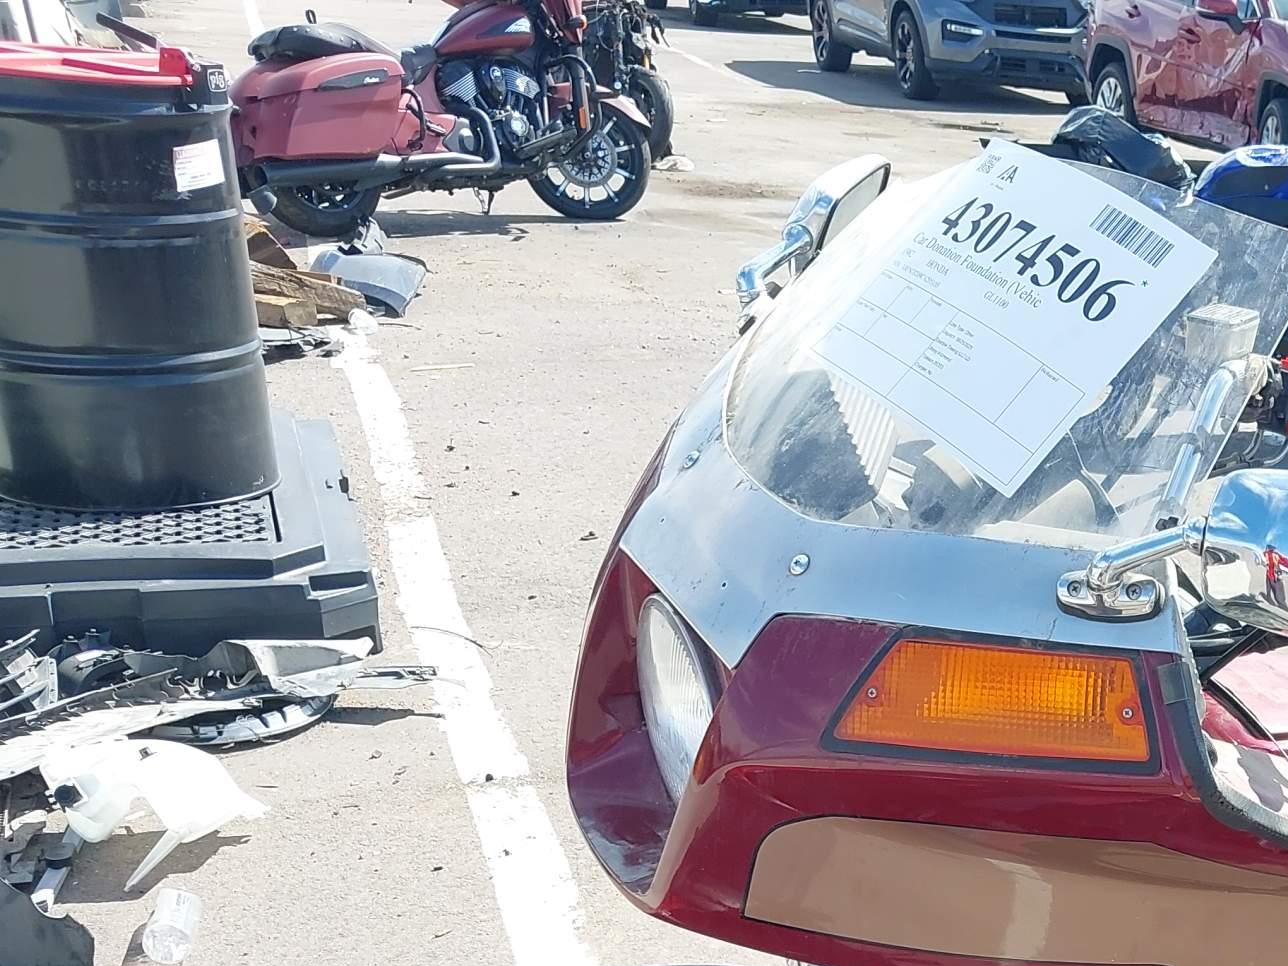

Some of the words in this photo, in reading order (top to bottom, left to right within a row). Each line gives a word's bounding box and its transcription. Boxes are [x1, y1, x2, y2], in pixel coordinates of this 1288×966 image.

[912, 231, 927, 246] Car
[926, 237, 962, 264] Donation
[960, 254, 1009, 289] Foundation
[1006, 280, 1044, 309] (Vehic
[941, 196, 1136, 322] 43074506
